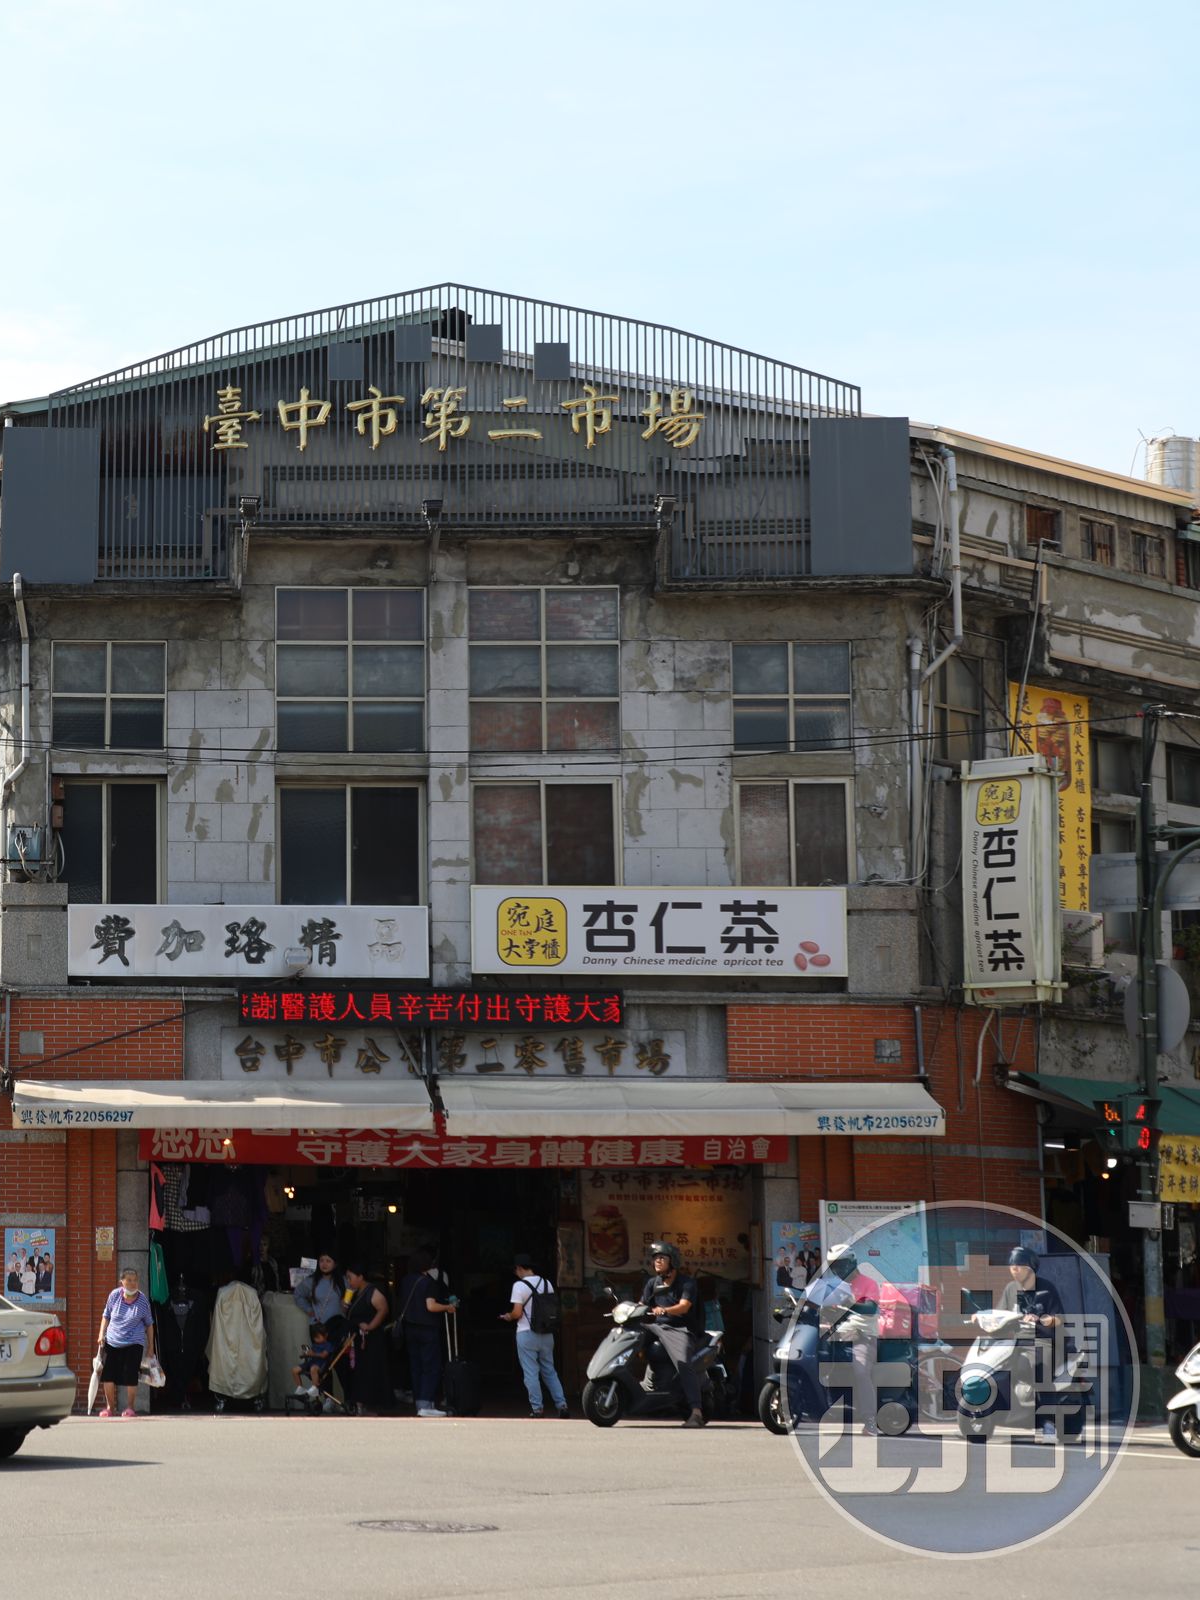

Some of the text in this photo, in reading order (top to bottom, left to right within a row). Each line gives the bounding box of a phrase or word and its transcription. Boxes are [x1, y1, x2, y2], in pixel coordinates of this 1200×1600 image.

[203, 384, 706, 451] 臺中市第二市場
[982, 828, 1025, 972] 杏仁茶
[507, 902, 558, 934] 宛庭
[582, 900, 779, 955] 杏仁茶
[503, 938, 561, 959] 大掌櫃
[582, 955, 784, 969] Danny Chinese medicine apricot tea
[296, 1139, 684, 1167] 守護大家身體健康
[703, 1137, 770, 1161] 自治會
